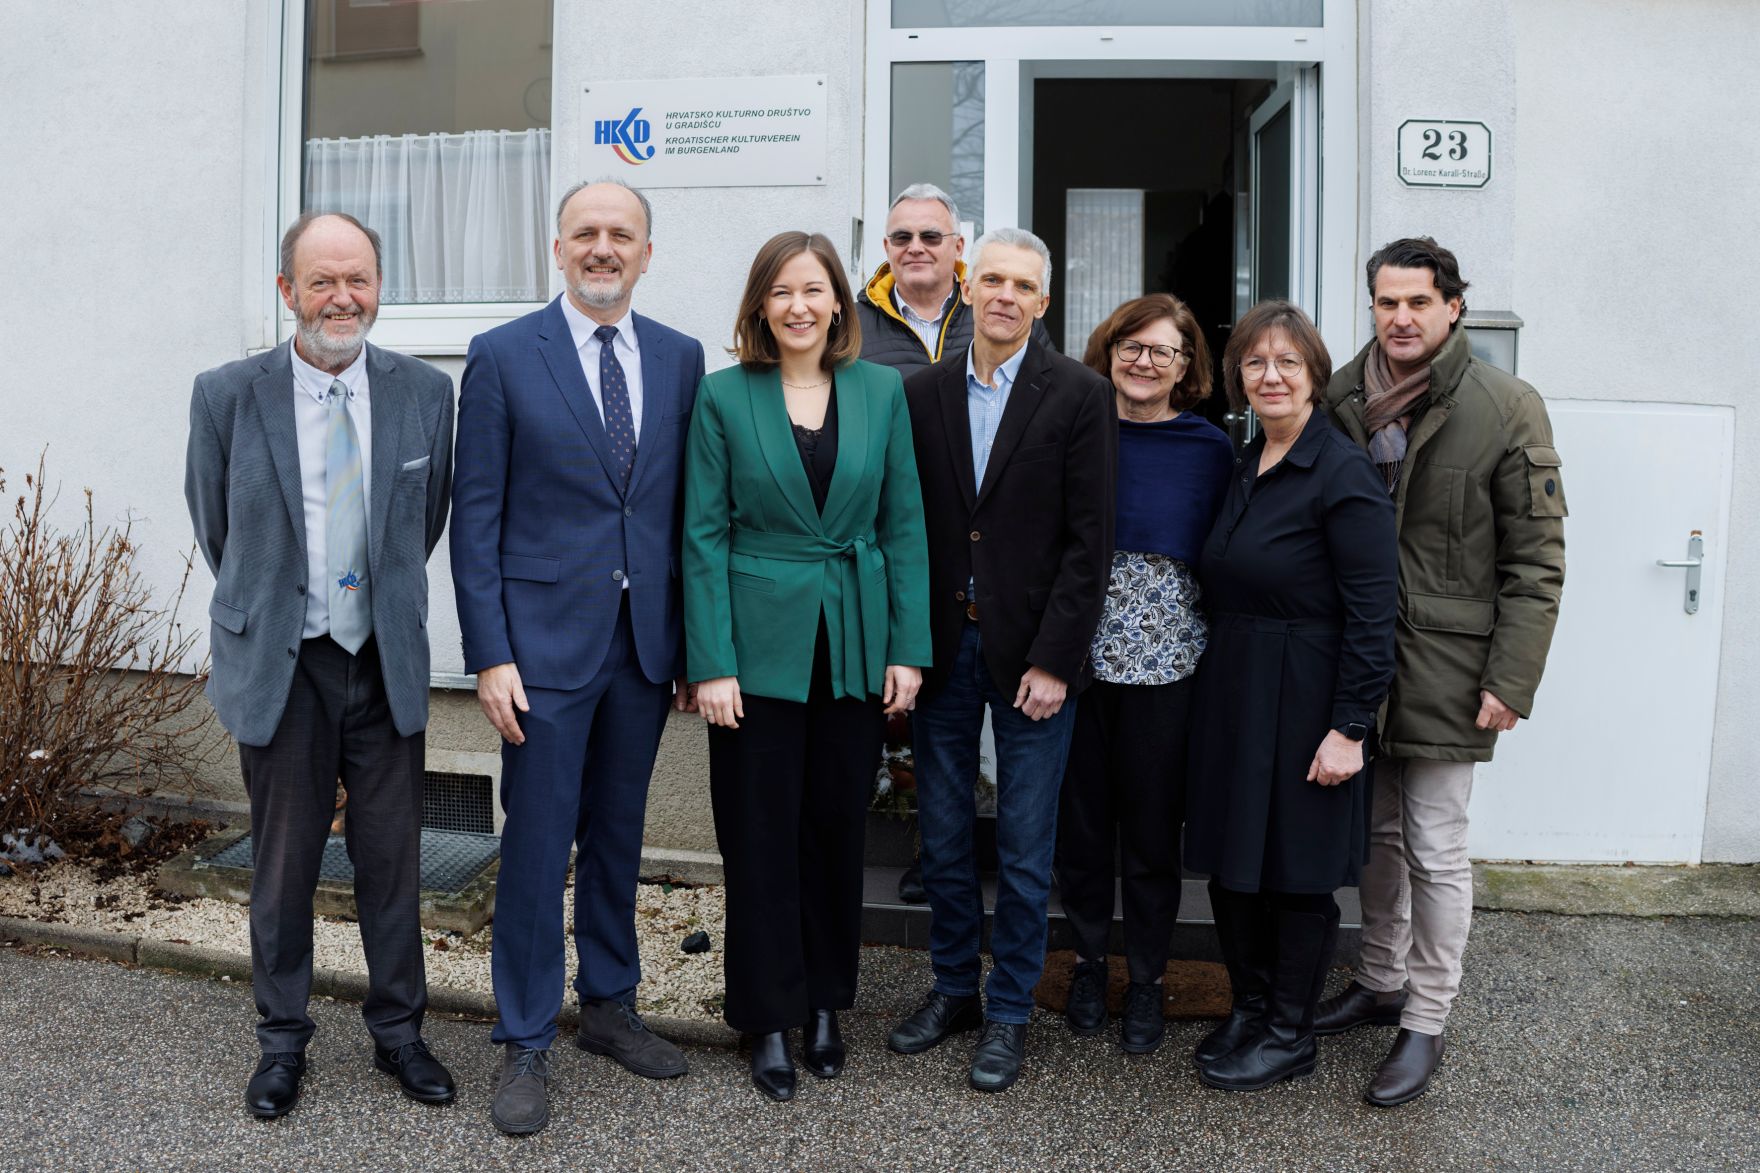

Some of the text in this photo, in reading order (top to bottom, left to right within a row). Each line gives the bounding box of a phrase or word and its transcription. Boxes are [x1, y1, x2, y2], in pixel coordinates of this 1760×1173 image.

[665, 108, 811, 119] HRVATSKO KULTURNO DRUŠTVO
[594, 108, 655, 161] HKD
[665, 134, 801, 144] KROATISCHER KULTURVEREIN
[1422, 128, 1468, 161] 23
[677, 146, 740, 154] BURGENLAND
[1413, 168, 1437, 177] Lorenz
